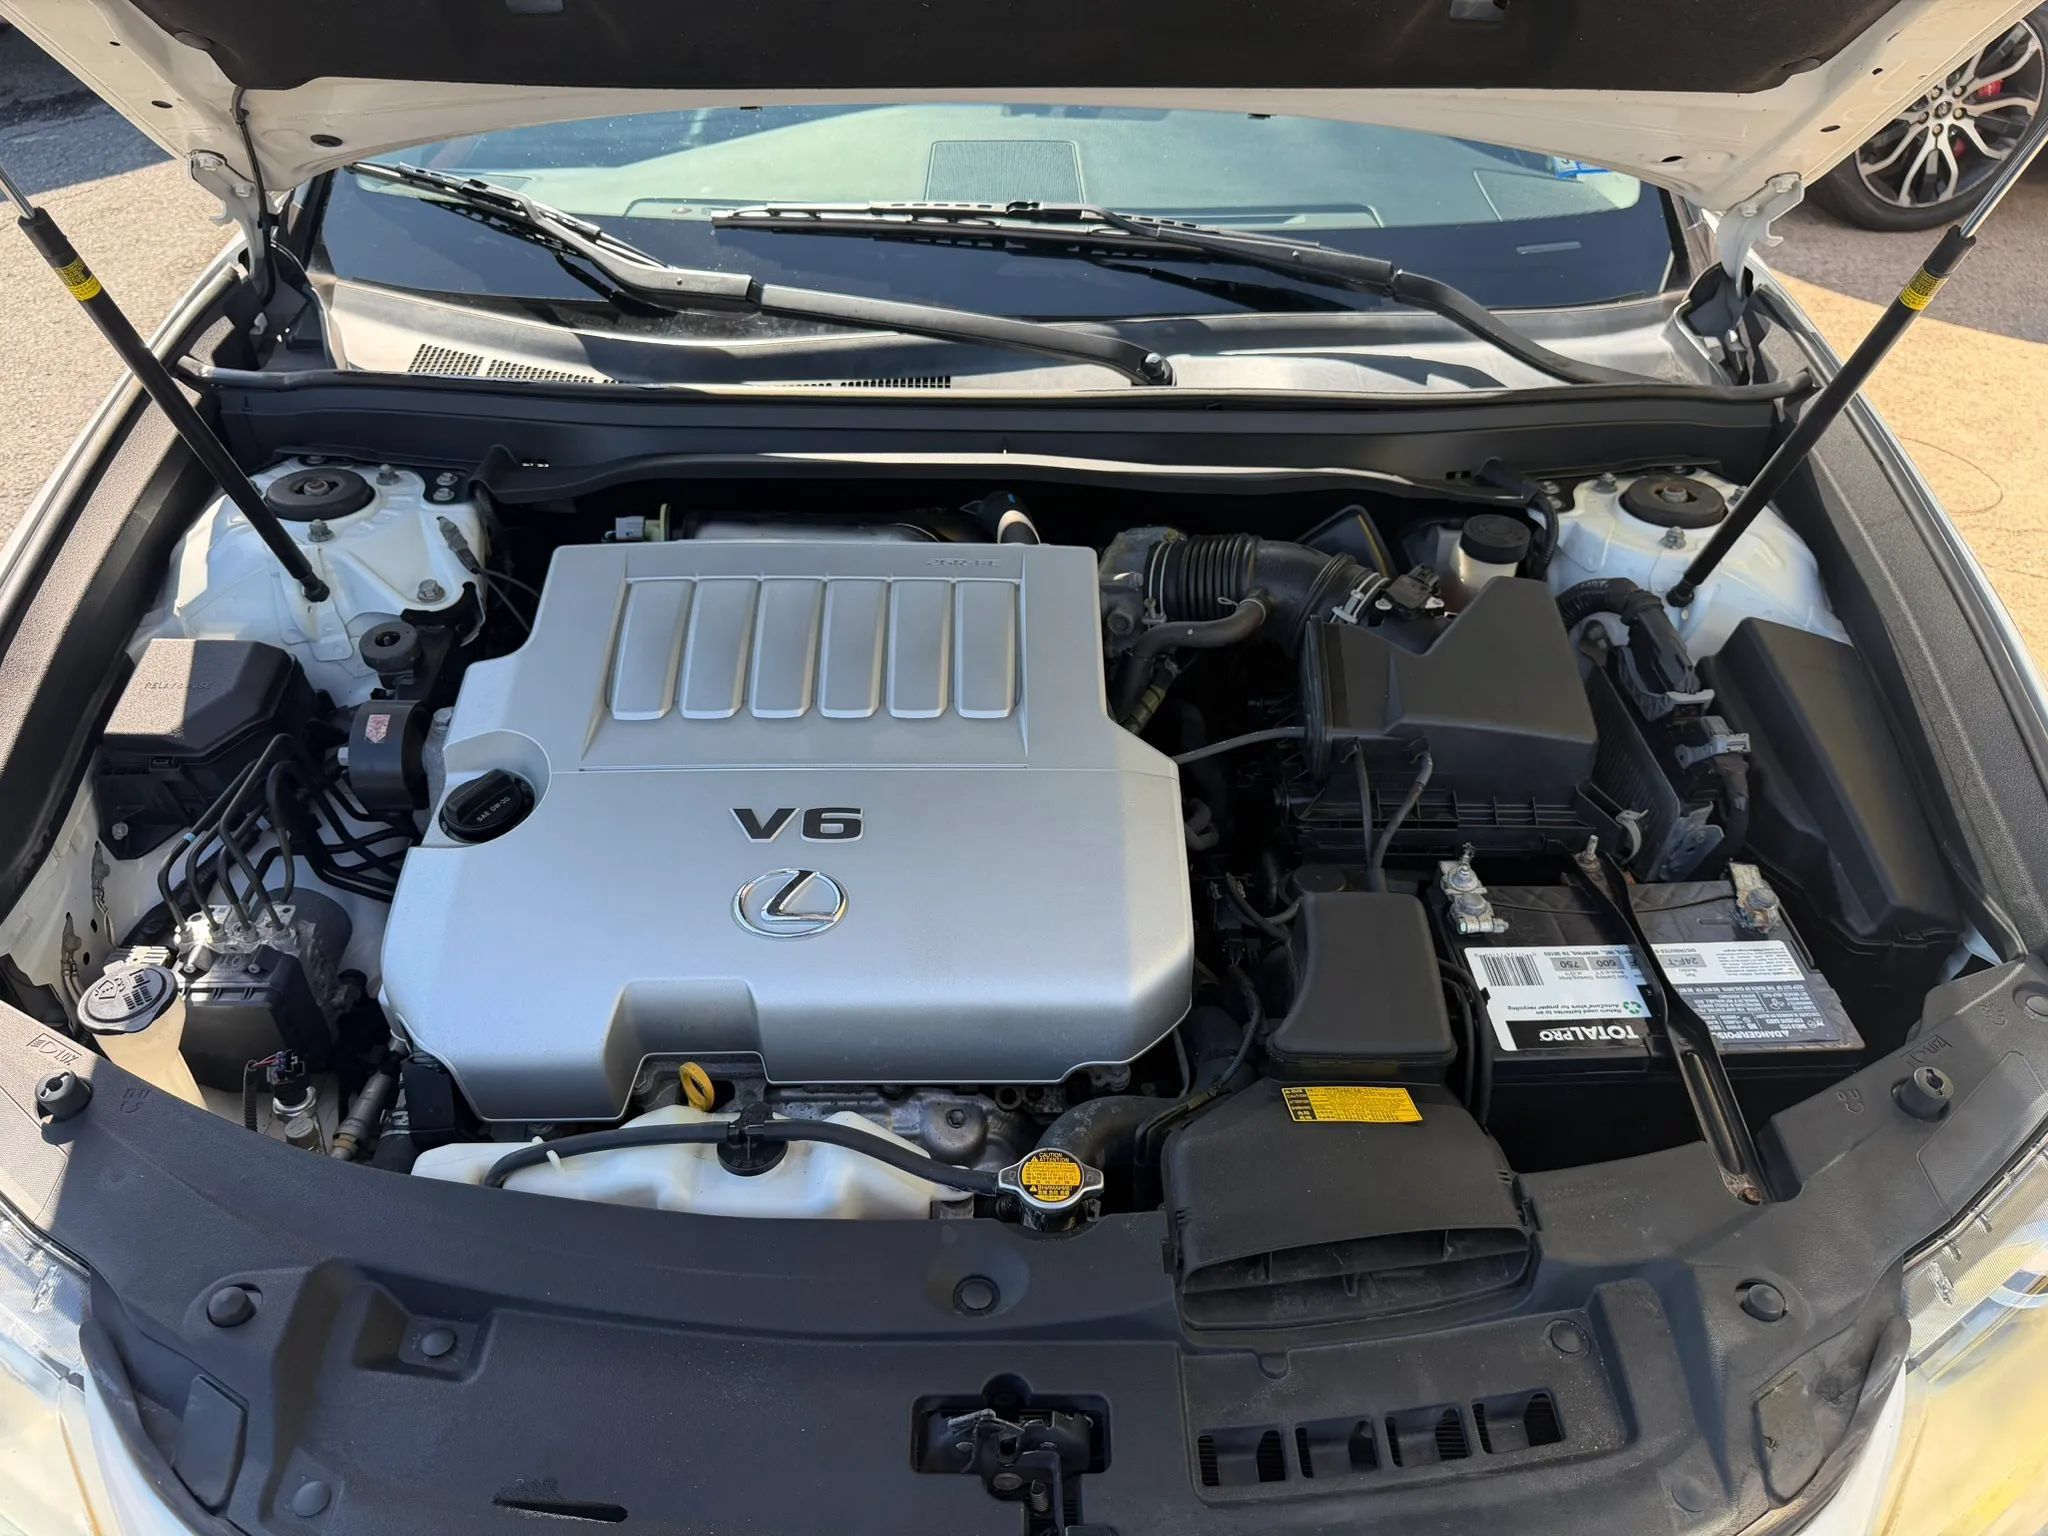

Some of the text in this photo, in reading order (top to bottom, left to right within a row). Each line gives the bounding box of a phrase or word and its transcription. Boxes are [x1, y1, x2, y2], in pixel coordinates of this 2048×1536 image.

[477, 811, 490, 822] SAE
[730, 807, 863, 843] V6
[1538, 1024, 1638, 1041] TOTALPRO
